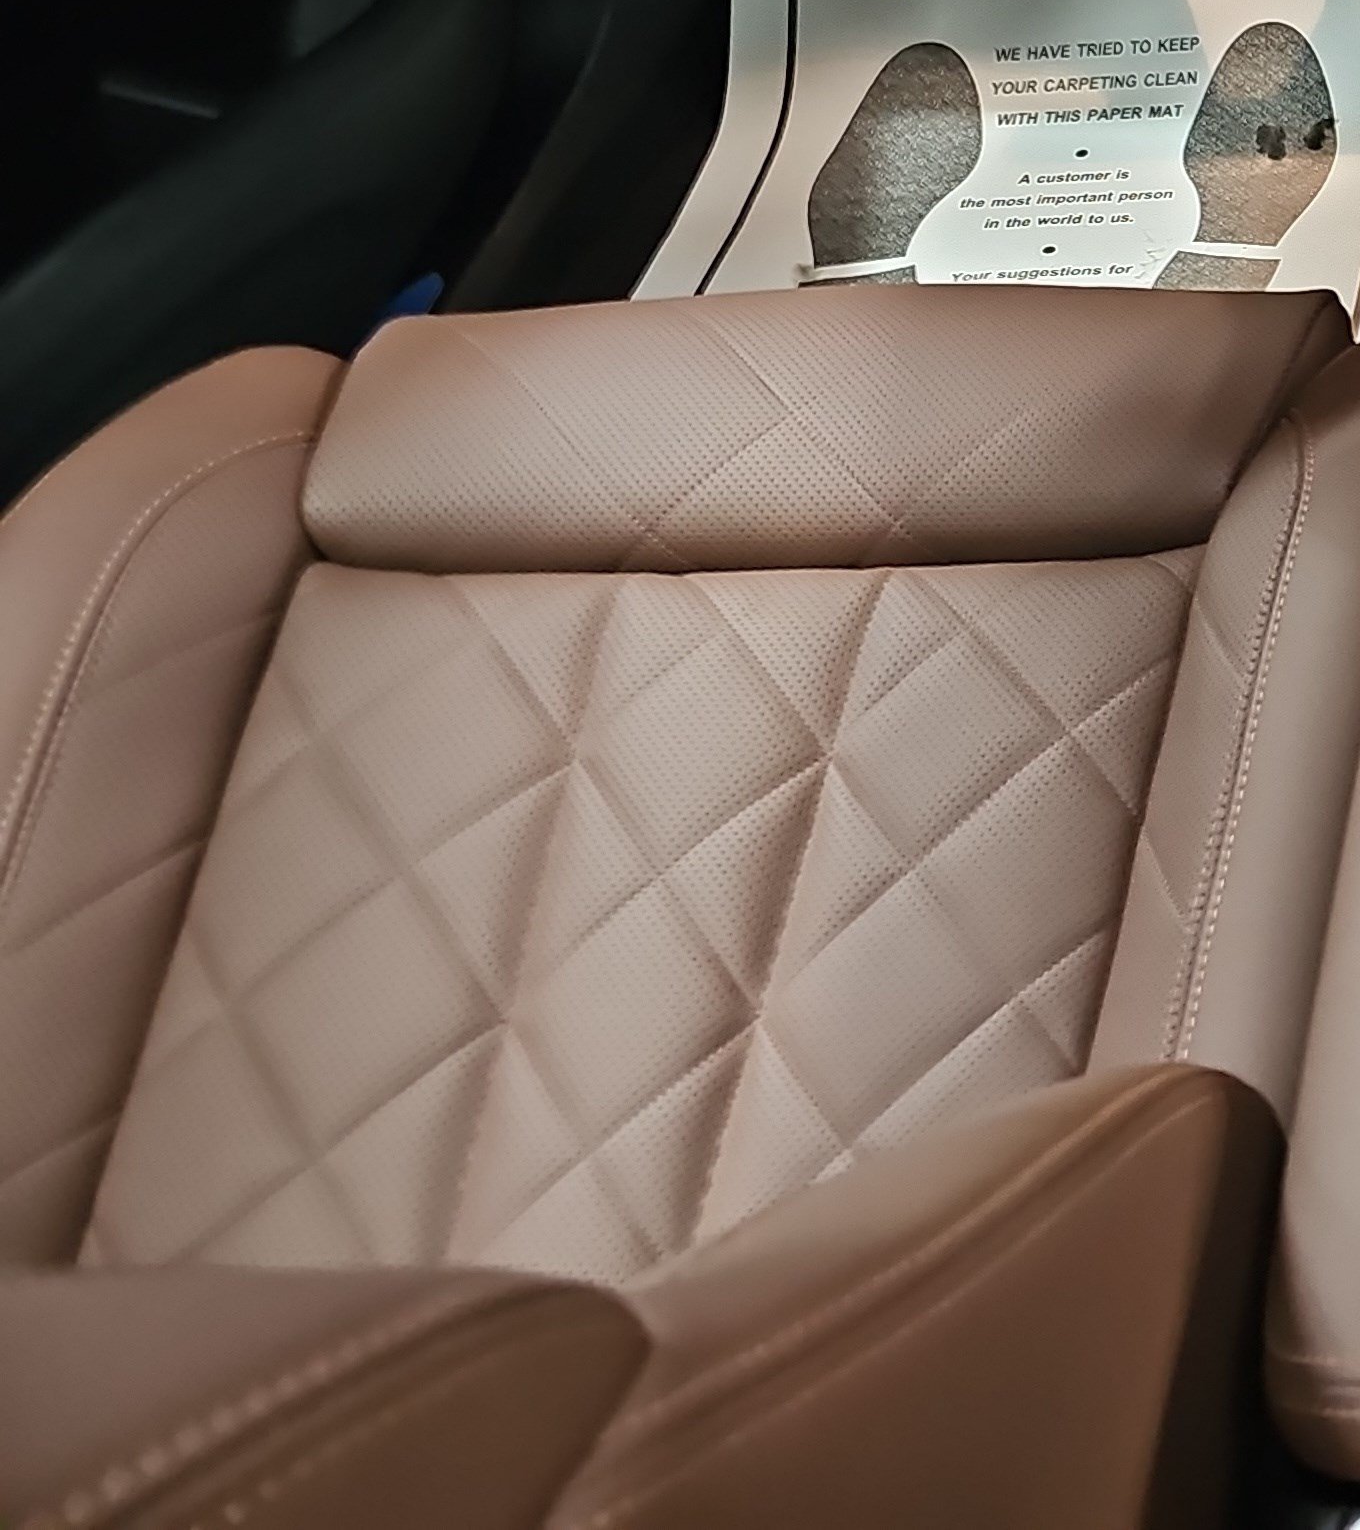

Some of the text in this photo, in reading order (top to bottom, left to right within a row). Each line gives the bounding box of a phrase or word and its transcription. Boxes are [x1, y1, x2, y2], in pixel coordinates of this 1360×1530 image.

[995, 36, 1200, 62] WE HAVE TRIED TO KEEP
[992, 71, 1198, 95] YOUR CARPETING CLEAN
[997, 104, 1184, 126] WITH THIS PAPER MAT
[1017, 169, 1129, 185] A customer is
[960, 189, 1173, 209] the most important person
[983, 213, 1135, 229] in the world to us.
[952, 264, 1134, 283] Your suggestions for
